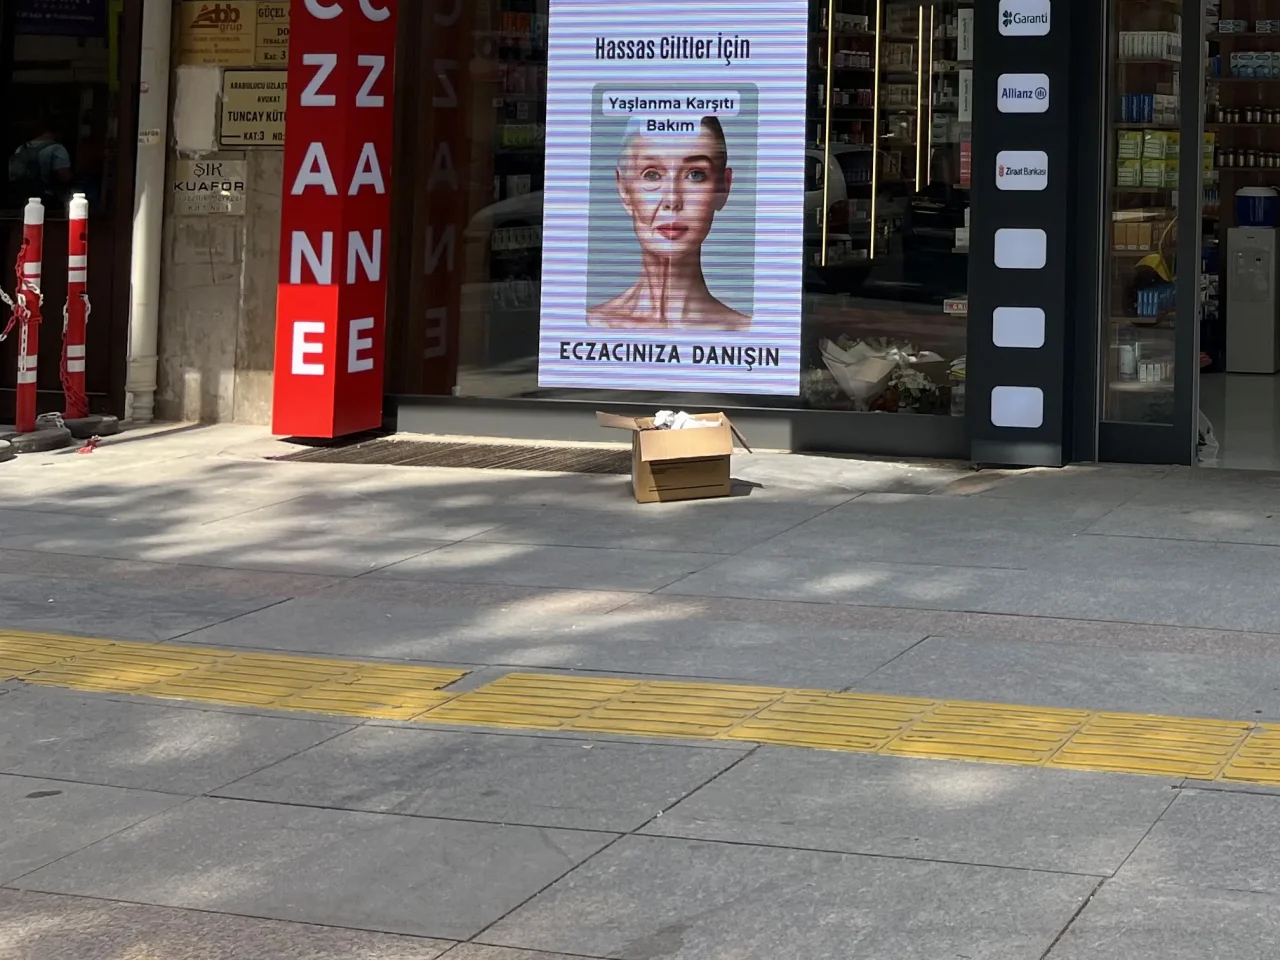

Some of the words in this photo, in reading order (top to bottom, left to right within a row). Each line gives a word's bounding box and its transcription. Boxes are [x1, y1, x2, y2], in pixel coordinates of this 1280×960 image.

[258, 5, 286, 20] GÜÇEL
[1013, 12, 1048, 24] Garanti
[220, 23, 243, 33] grup
[280, 50, 286, 60] 3
[595, 37, 655, 59] Hassas
[660, 34, 713, 59] Ciltler
[717, 32, 750, 66] İçin
[1001, 88, 1033, 99] Allianz
[609, 97, 683, 111] Yaşlanma
[686, 97, 734, 111] Karşıtı
[228, 111, 264, 122] TUNCAY
[646, 119, 695, 132] Bakım
[1005, 167, 1023, 176] Ziraat
[1023, 167, 1046, 176] Bankası
[173, 178, 244, 191] KUAFÖR
[560, 341, 681, 363] ECZACINIZA
[692, 345, 780, 371] DANIŞIN
